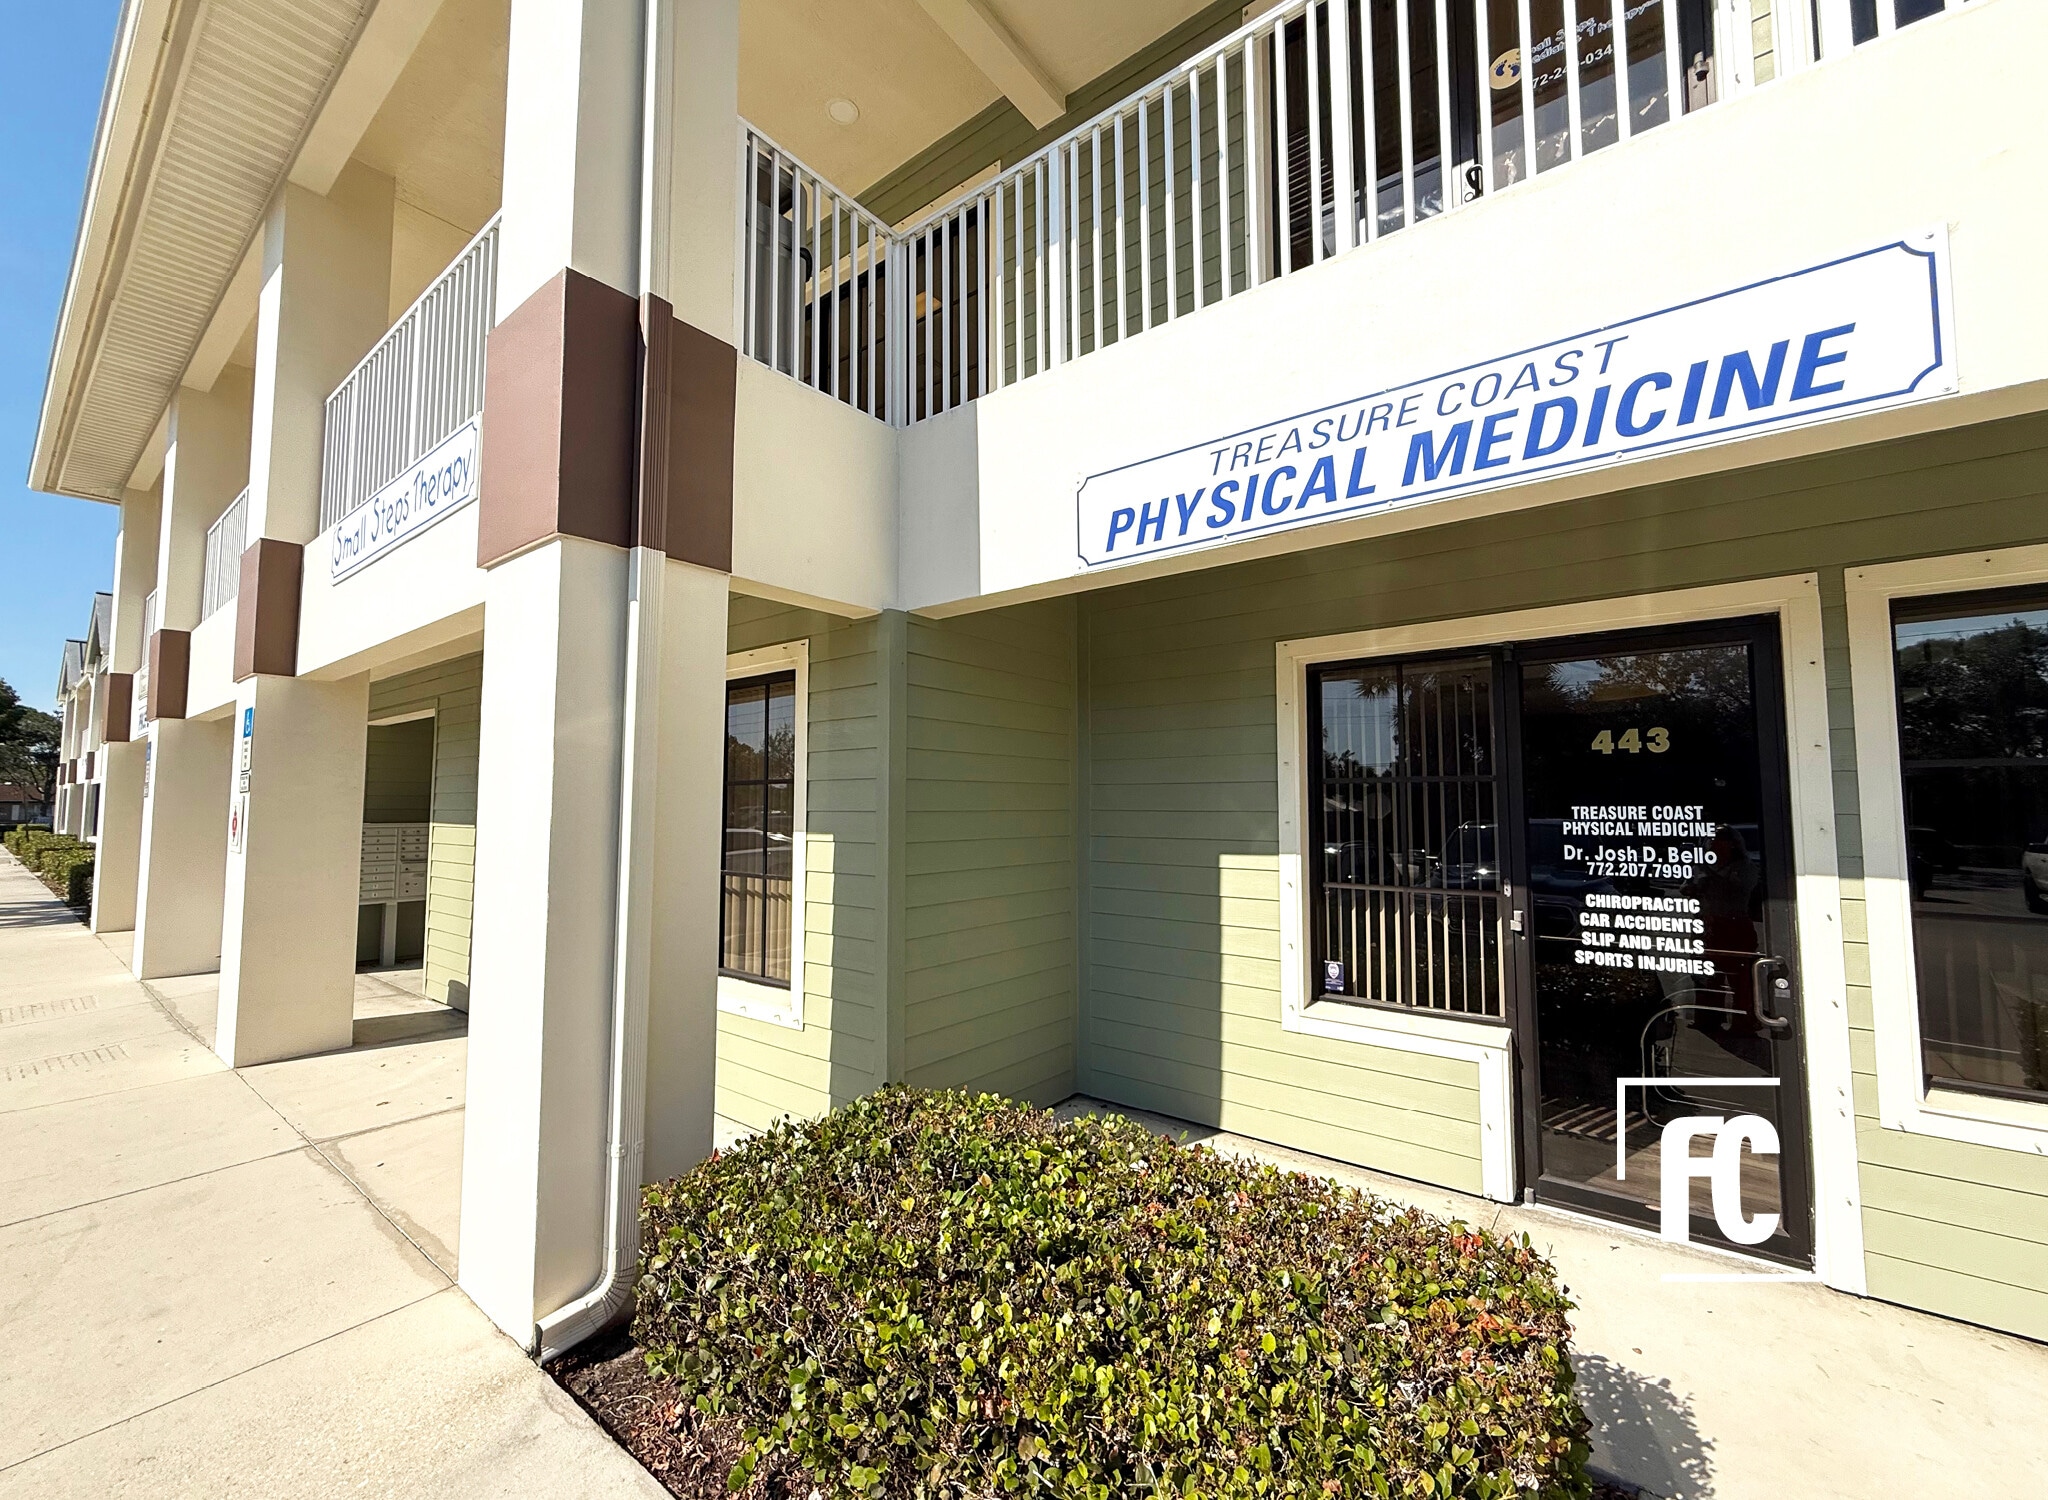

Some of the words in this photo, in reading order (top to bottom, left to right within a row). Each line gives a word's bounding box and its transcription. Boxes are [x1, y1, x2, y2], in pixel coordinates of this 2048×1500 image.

[1210, 394, 1421, 476] TREASURE
[1436, 335, 1629, 418] COAST
[1105, 446, 1376, 553] PHYSICAL
[1401, 322, 1856, 487] MEDICINE
[334, 514, 367, 567] Small
[371, 490, 410, 542] Steps
[413, 448, 472, 512] Therapy
[1591, 727, 1670, 754] 443
[1571, 805, 1648, 820] TREASURE
[1651, 805, 1704, 821] COAST
[1562, 821, 1634, 836] PHYSICAL
[1637, 821, 1716, 838] MEDICINE
[1563, 844, 1590, 861] Dr.
[1594, 845, 1638, 862] Josh
[1642, 846, 1663, 863] D.
[1667, 847, 1718, 865] Bello
[1586, 861, 1693, 879] 772.207.7990
[1585, 893, 1701, 914] CHIROPRACTIC
[1579, 912, 1611, 928] CAR
[1613, 914, 1705, 935] ACCIDENTS
[1581, 931, 1618, 947] SLIP
[1618, 934, 1653, 951] AND
[1655, 936, 1705, 955] FALLS
[1574, 949, 1634, 969] SPORTS
[1637, 954, 1716, 976] INJURIES
